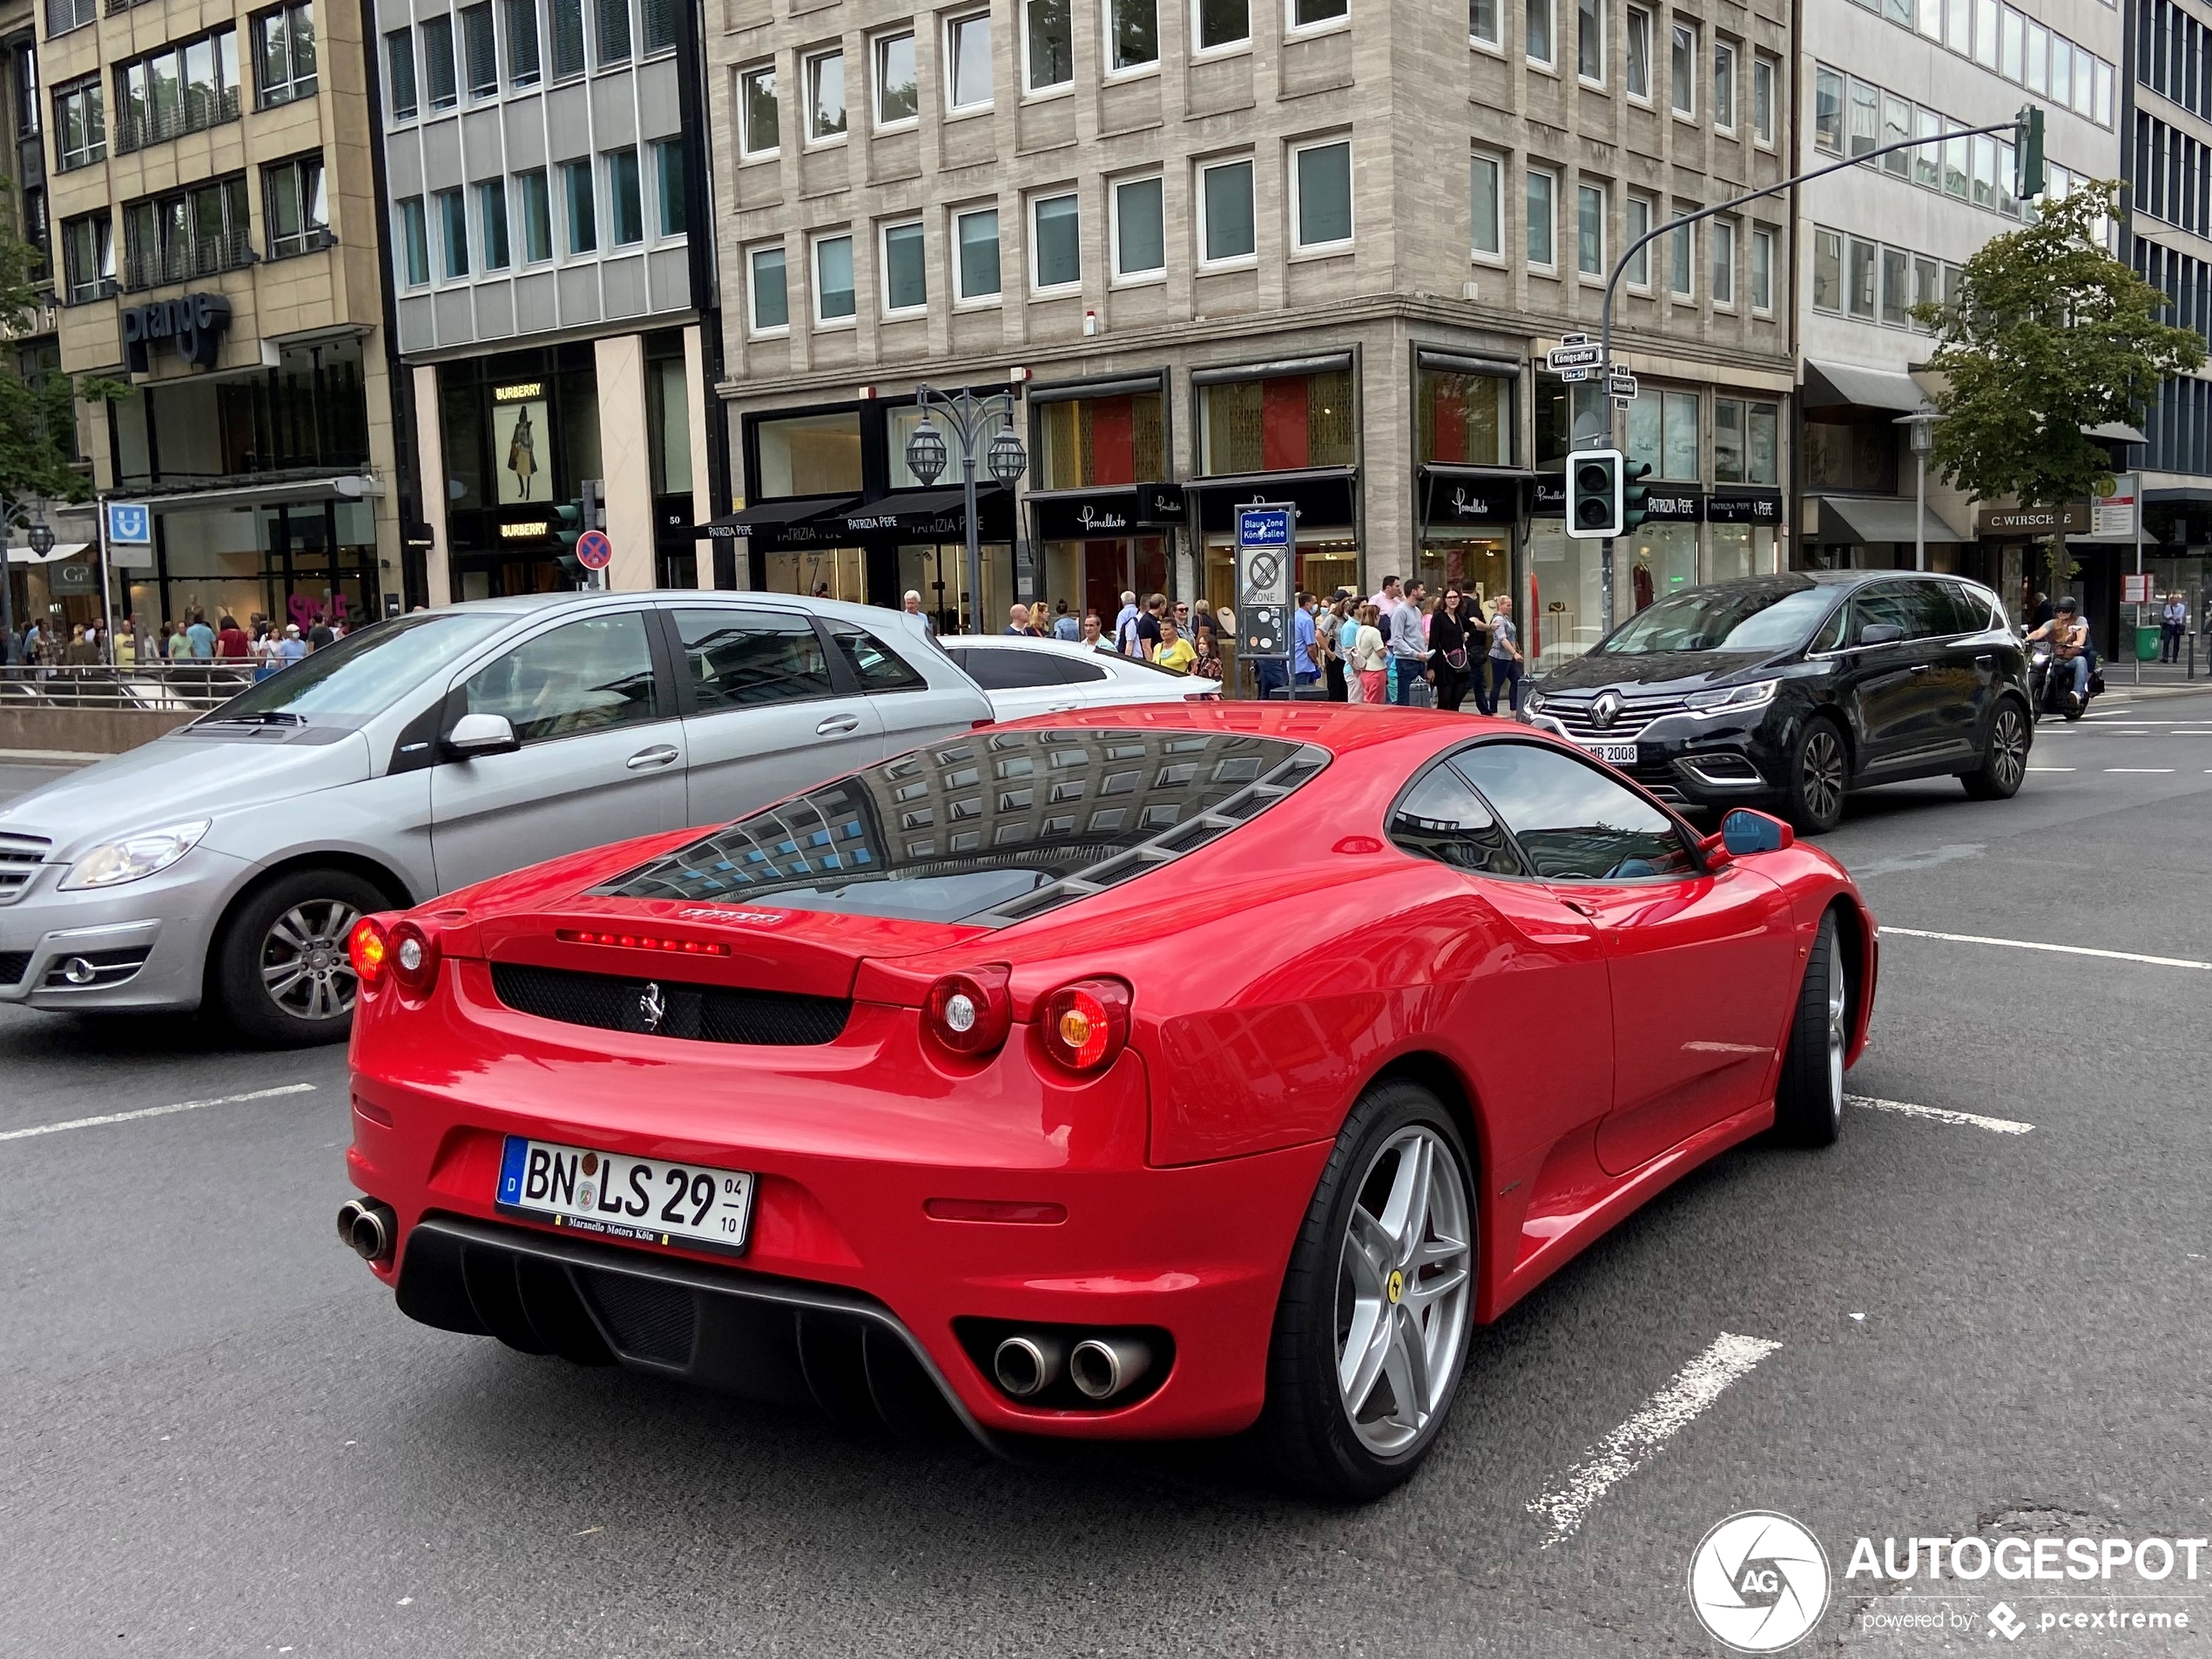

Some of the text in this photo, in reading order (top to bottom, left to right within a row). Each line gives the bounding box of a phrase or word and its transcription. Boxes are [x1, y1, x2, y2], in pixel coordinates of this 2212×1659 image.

[120, 293, 215, 373] prange
[1554, 351, 1593, 364] Königsallee
[496, 383, 541, 401] BURBERRY
[1155, 495, 1182, 512] Pomellato
[1452, 487, 1488, 515] Pomellato
[1648, 496, 1694, 514] PATRIZIA PEPE
[1758, 501, 1773, 516] PEPE
[670, 516, 680, 524] 50
[847, 516, 898, 530] PATRIZIA PEPE
[1076, 505, 1127, 530] Pomellato
[1244, 519, 1284, 529] Blaue Zone
[2004, 513, 2072, 525] WIRSCHE
[502, 523, 547, 537] BURBERRY
[708, 524, 753, 537] PATRIZIA PEPE
[1252, 592, 1276, 602] ZONE
[1608, 746, 1635, 760] 2008
[507, 1177, 516, 1192] D
[525, 1148, 716, 1226] BN LS 29
[725, 1178, 742, 1196] 04
[568, 1217, 654, 1241] Maranello Motors Köln
[721, 1216, 737, 1232] 10
